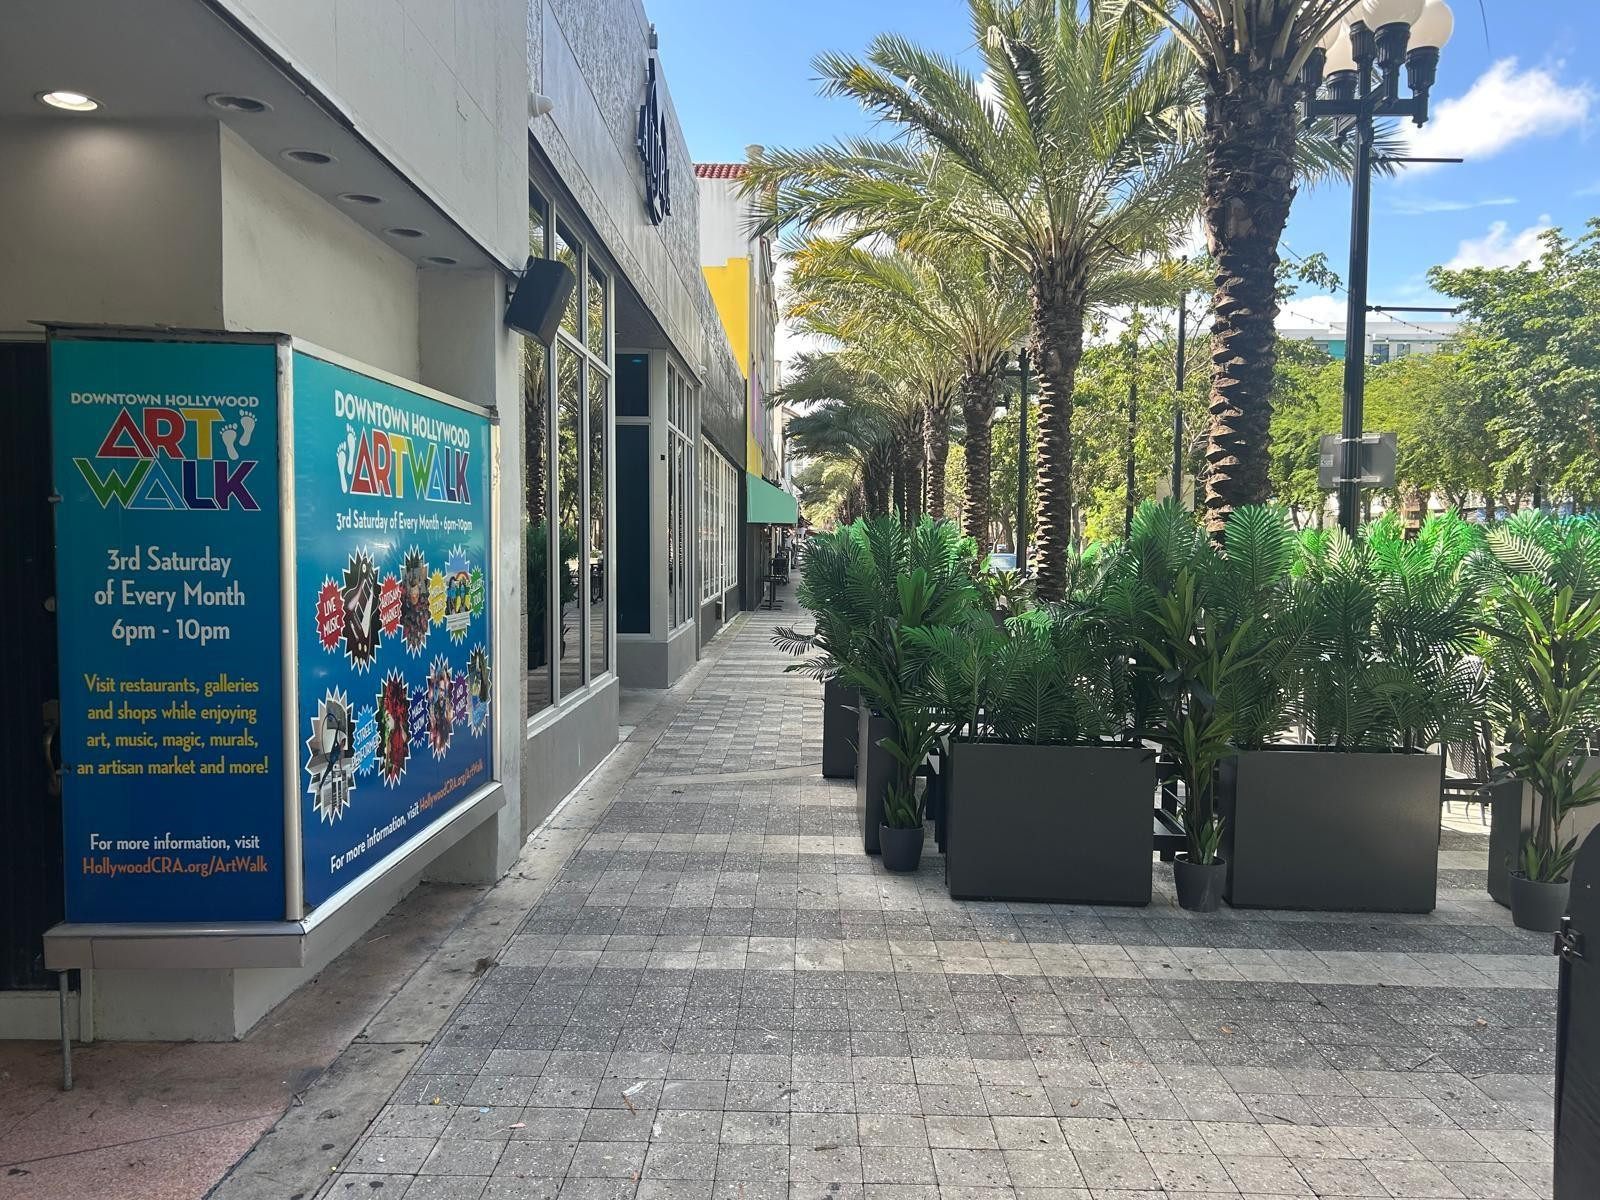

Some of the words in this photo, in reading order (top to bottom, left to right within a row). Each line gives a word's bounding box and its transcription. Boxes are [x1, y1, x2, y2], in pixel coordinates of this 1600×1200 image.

[71, 393, 161, 406] DOWNTOWN
[165, 395, 259, 407] HOLLYWOOD
[334, 389, 409, 430] DOWNTOWN
[412, 414, 470, 448] HOLLYWOOD
[95, 407, 225, 459] ART
[73, 457, 261, 511] WALK
[336, 508, 351, 531] 3rd
[353, 509, 388, 534] Saturday
[390, 511, 398, 529] of
[399, 511, 418, 534] Every
[419, 513, 439, 530] Month
[107, 545, 141, 571] 3rd
[147, 546, 232, 578] Saturday
[94, 579, 115, 605] of
[121, 580, 176, 612] Every
[183, 580, 246, 606] Month
[323, 596, 336, 617] LIVE
[111, 618, 156, 646] 6pm
[175, 618, 230, 646] 10pm
[323, 615, 340, 637] MUSIC
[84, 674, 115, 692] Visit
[120, 677, 200, 694] restaurants,
[204, 673, 259, 697] galleries
[88, 701, 113, 720] and
[118, 701, 157, 724] shops
[162, 700, 196, 720] while
[201, 704, 257, 724] enjoying
[87, 732, 111, 749] art,
[115, 730, 157, 749] music,
[163, 731, 205, 752] magic,
[210, 728, 258, 748] murals,
[357, 720, 373, 745] STREET
[77, 762, 94, 774] an
[98, 760, 143, 775] artisan
[148, 755, 195, 775] market
[200, 755, 225, 775] and
[229, 756, 268, 774] more!
[90, 833, 112, 850] For
[117, 838, 149, 850] more
[153, 832, 230, 851] information,
[235, 835, 260, 849] visit
[330, 854, 345, 874] For
[346, 842, 366, 863] more
[366, 816, 406, 849] information,
[407, 802, 420, 820] visit
[82, 855, 268, 878] HollywoodCRA.org/ArtWalk
